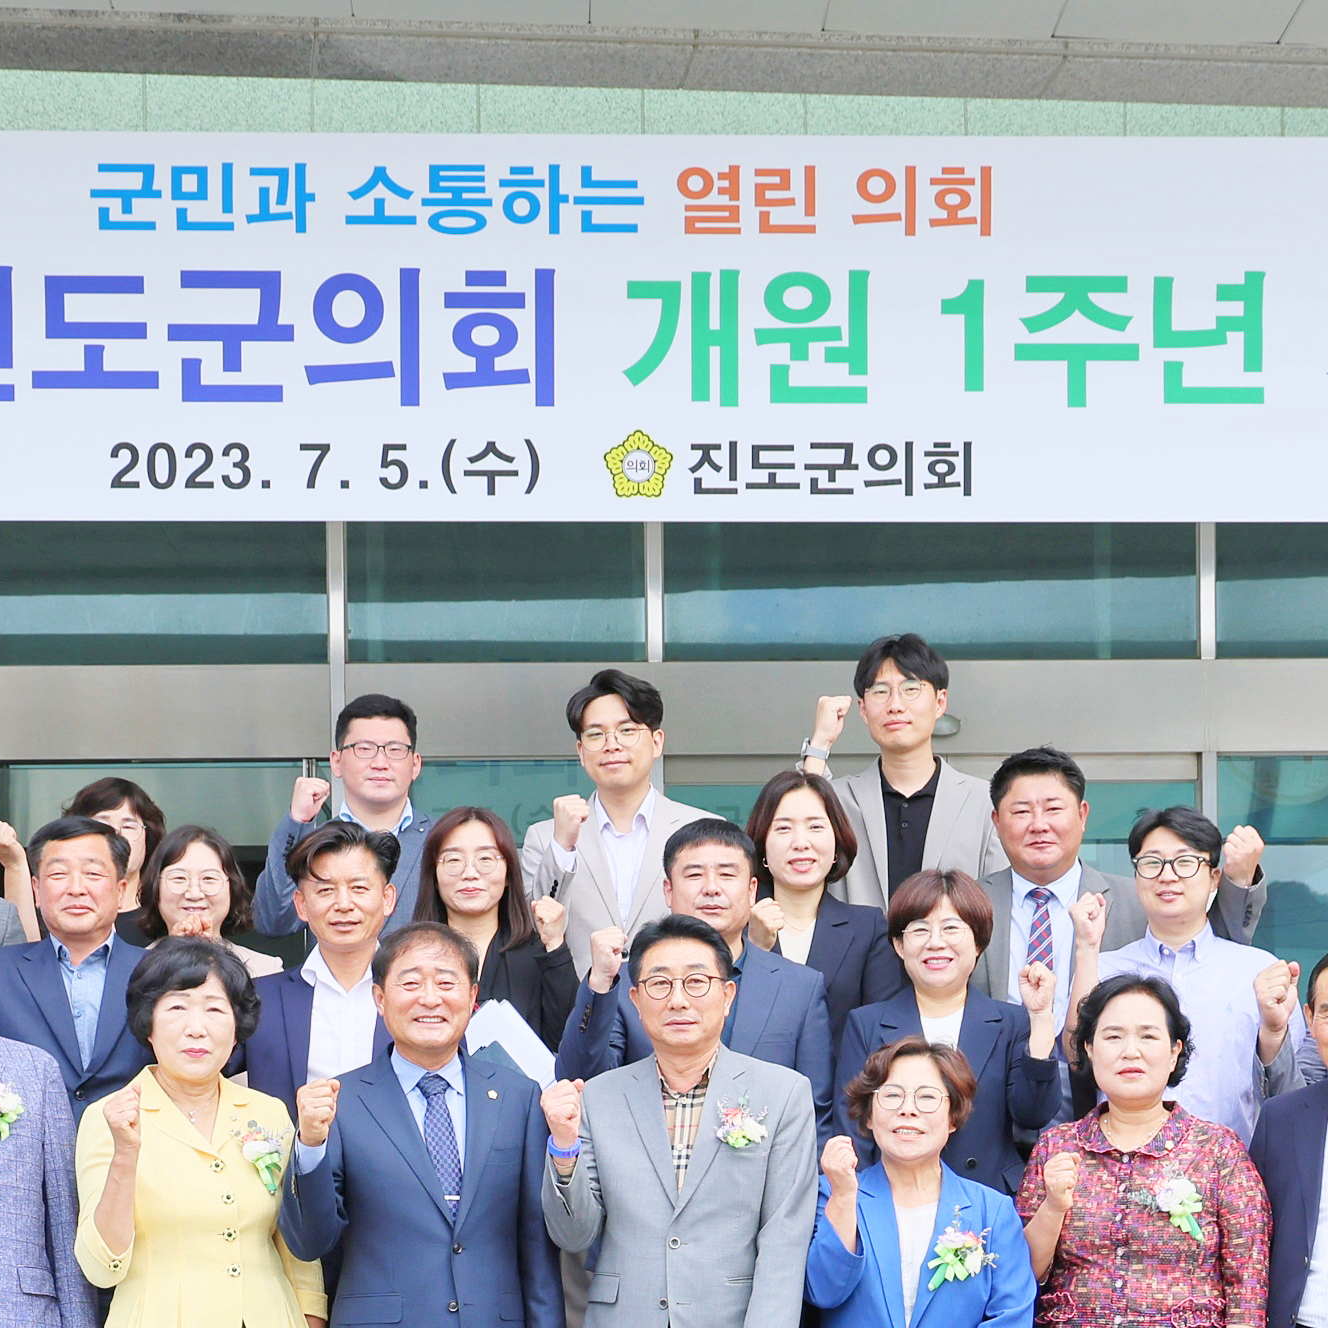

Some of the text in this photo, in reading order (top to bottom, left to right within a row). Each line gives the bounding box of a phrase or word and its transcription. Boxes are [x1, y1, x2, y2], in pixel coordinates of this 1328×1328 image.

[90, 162, 991, 236] 군민과 소통하는 열린 의회
[624, 270, 870, 407] 개원
[941, 271, 1266, 408] 1주년
[110, 439, 539, 496] 2023. 7. 5.(수)
[626, 459, 650, 473] 의회
[688, 441, 972, 496] 진도군의회
